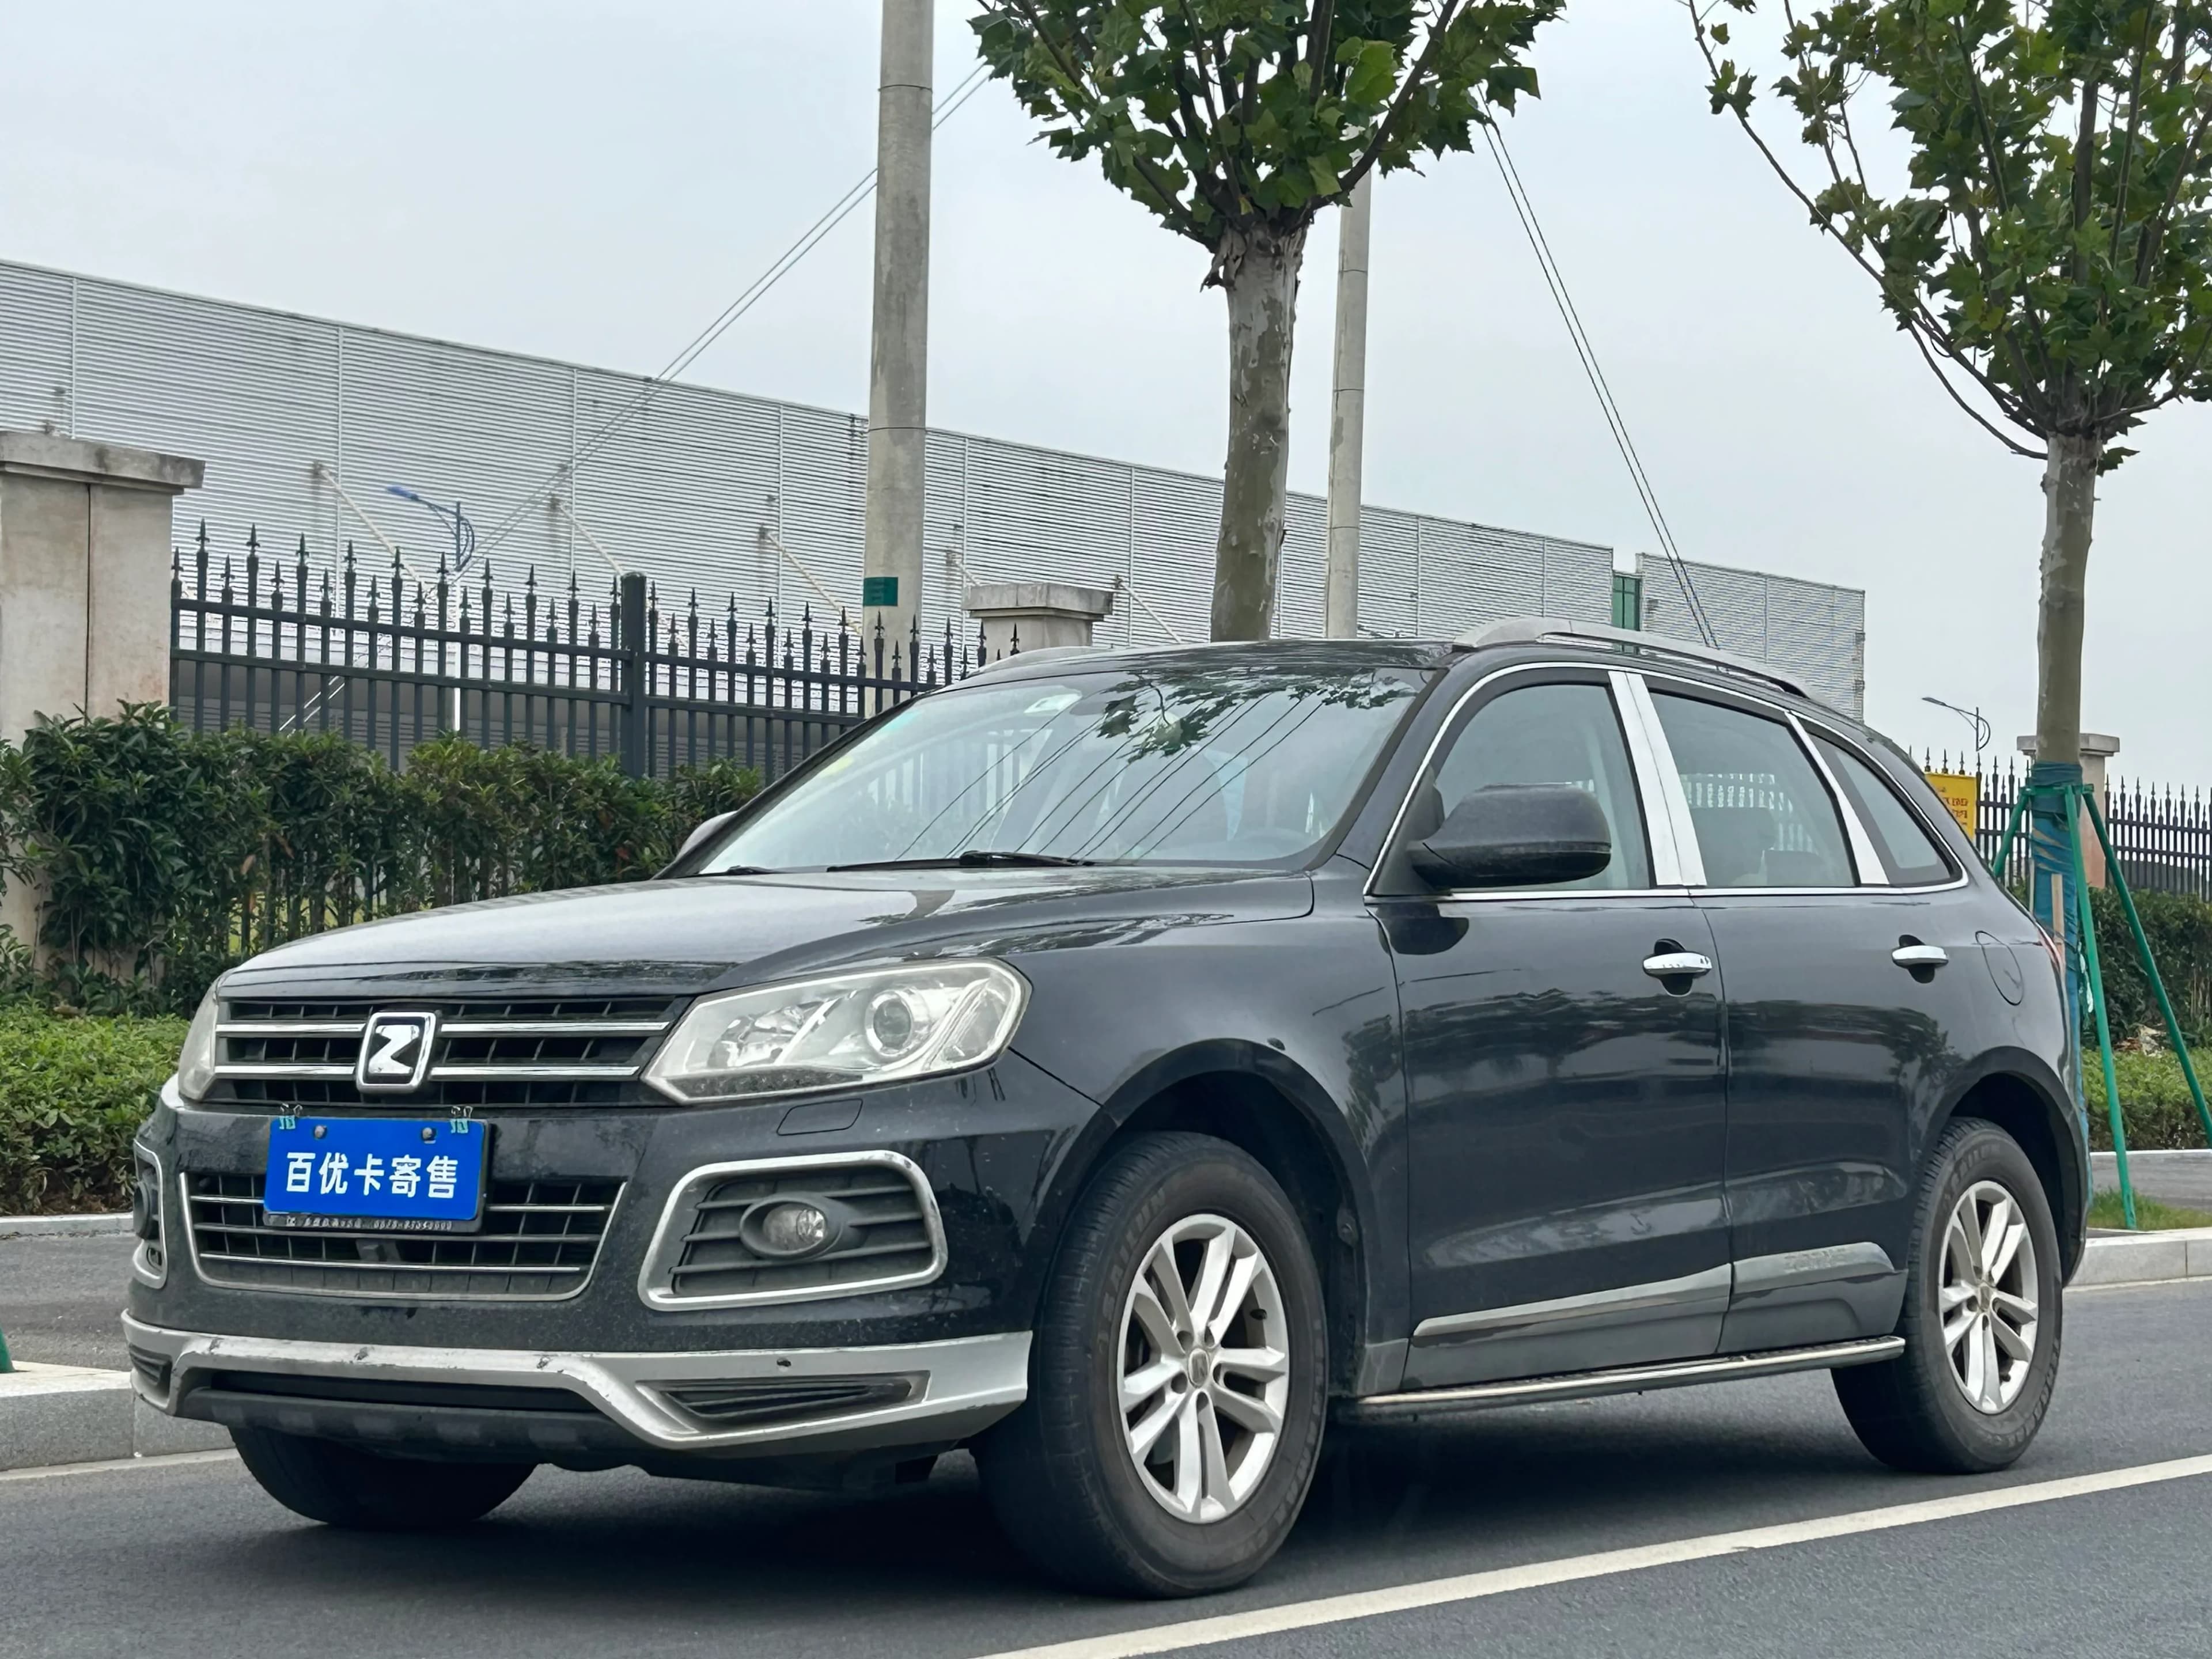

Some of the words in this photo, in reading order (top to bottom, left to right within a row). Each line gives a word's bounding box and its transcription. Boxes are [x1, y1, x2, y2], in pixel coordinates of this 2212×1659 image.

[286, 1152, 459, 1199] 百优卡寄售
